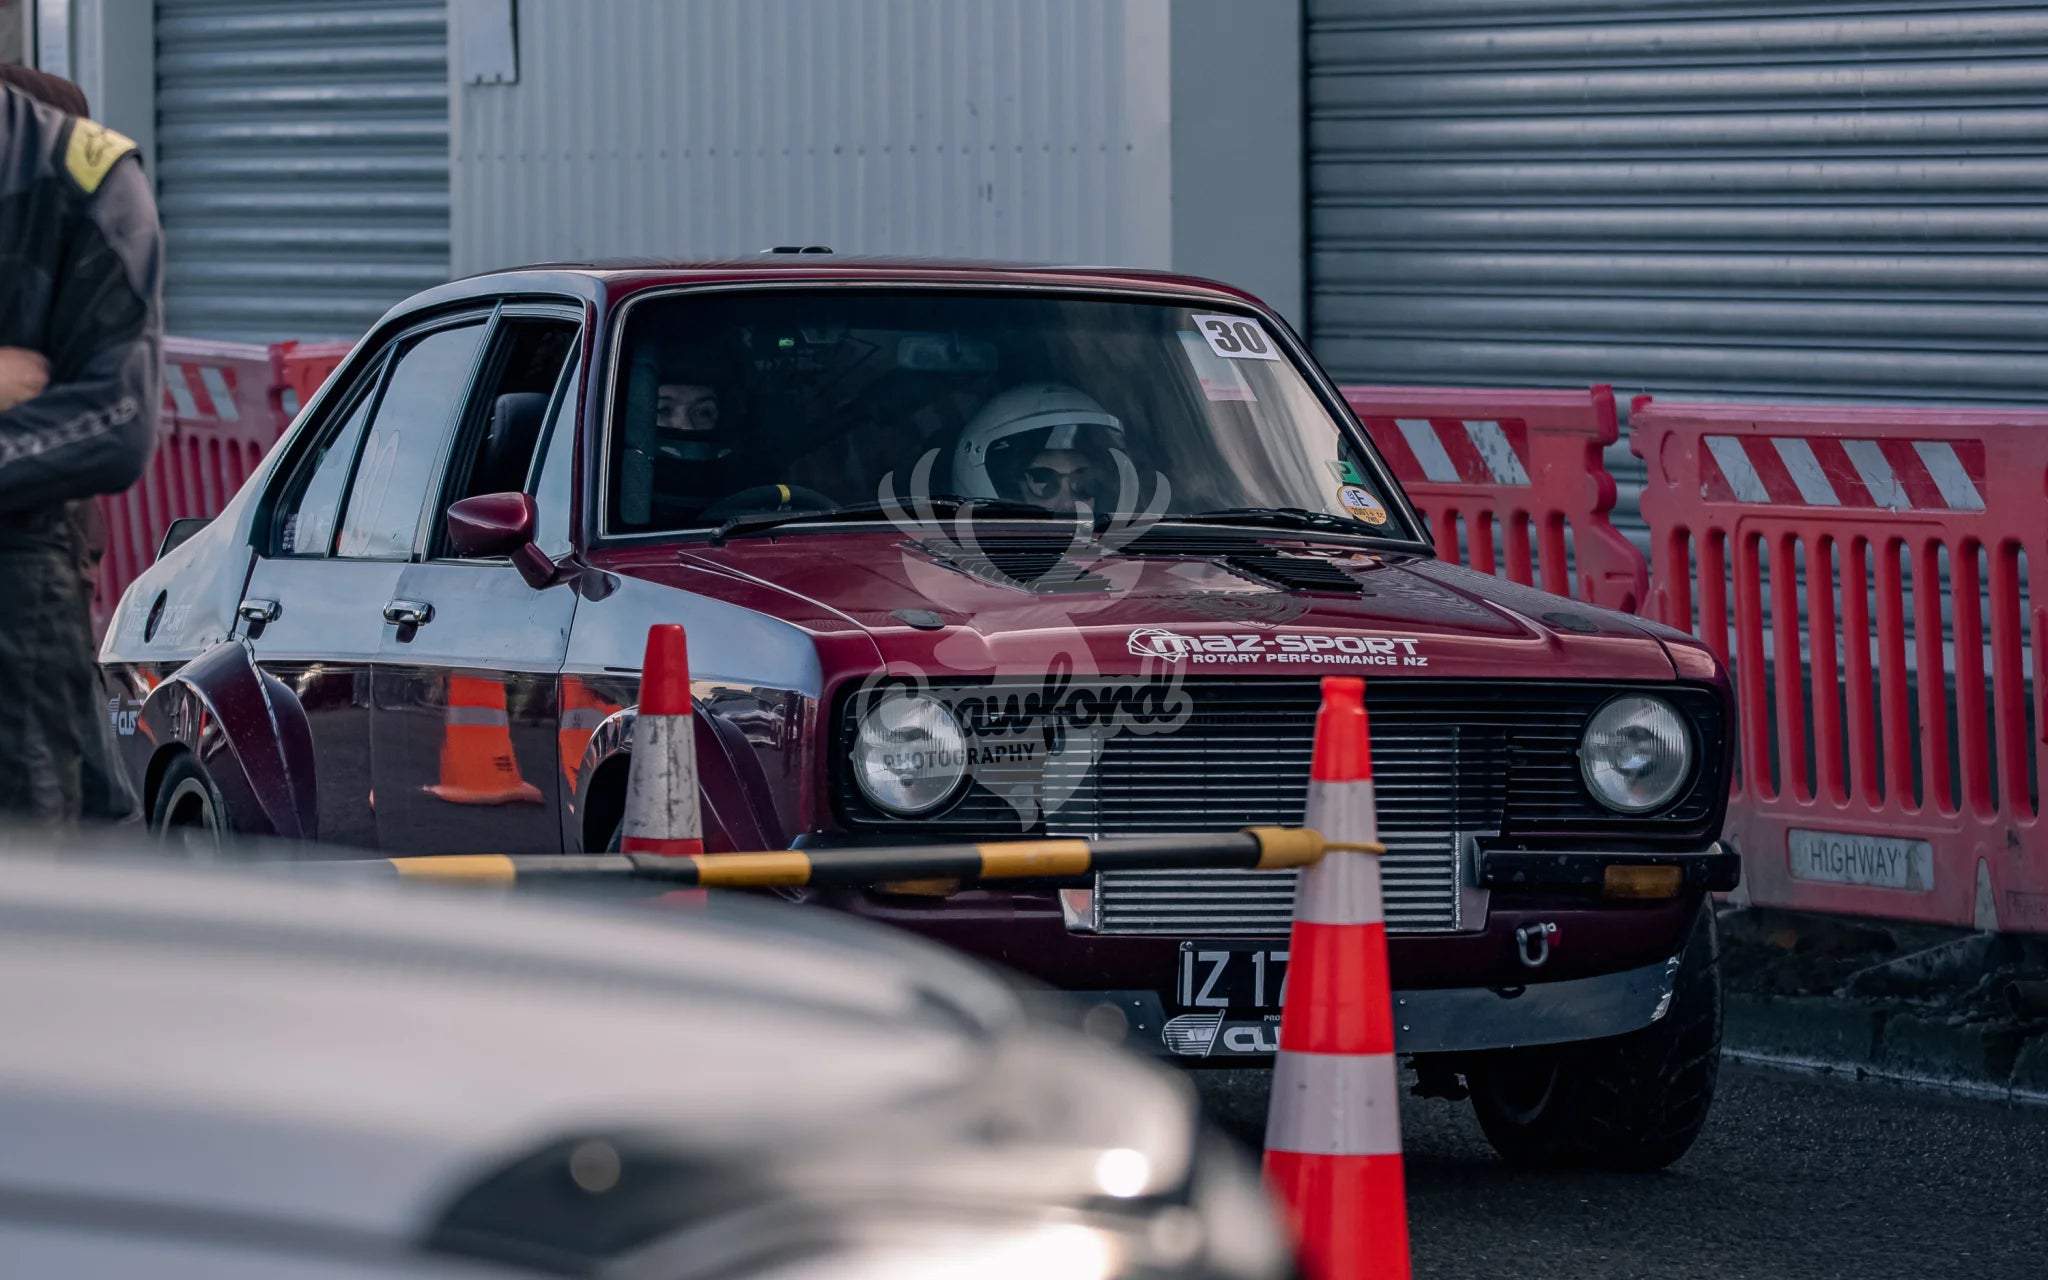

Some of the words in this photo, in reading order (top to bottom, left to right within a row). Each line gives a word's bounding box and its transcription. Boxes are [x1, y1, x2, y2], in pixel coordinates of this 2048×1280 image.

[1205, 320, 1268, 354] 30
[1351, 489, 1370, 507] E
[1192, 653, 1260, 664] ROTARY
[1265, 653, 1398, 666] PERFORMANCE
[1403, 656, 1429, 667] NZ
[1809, 840, 1899, 879] HIGHWAY
[1182, 951, 1230, 1007] IZ
